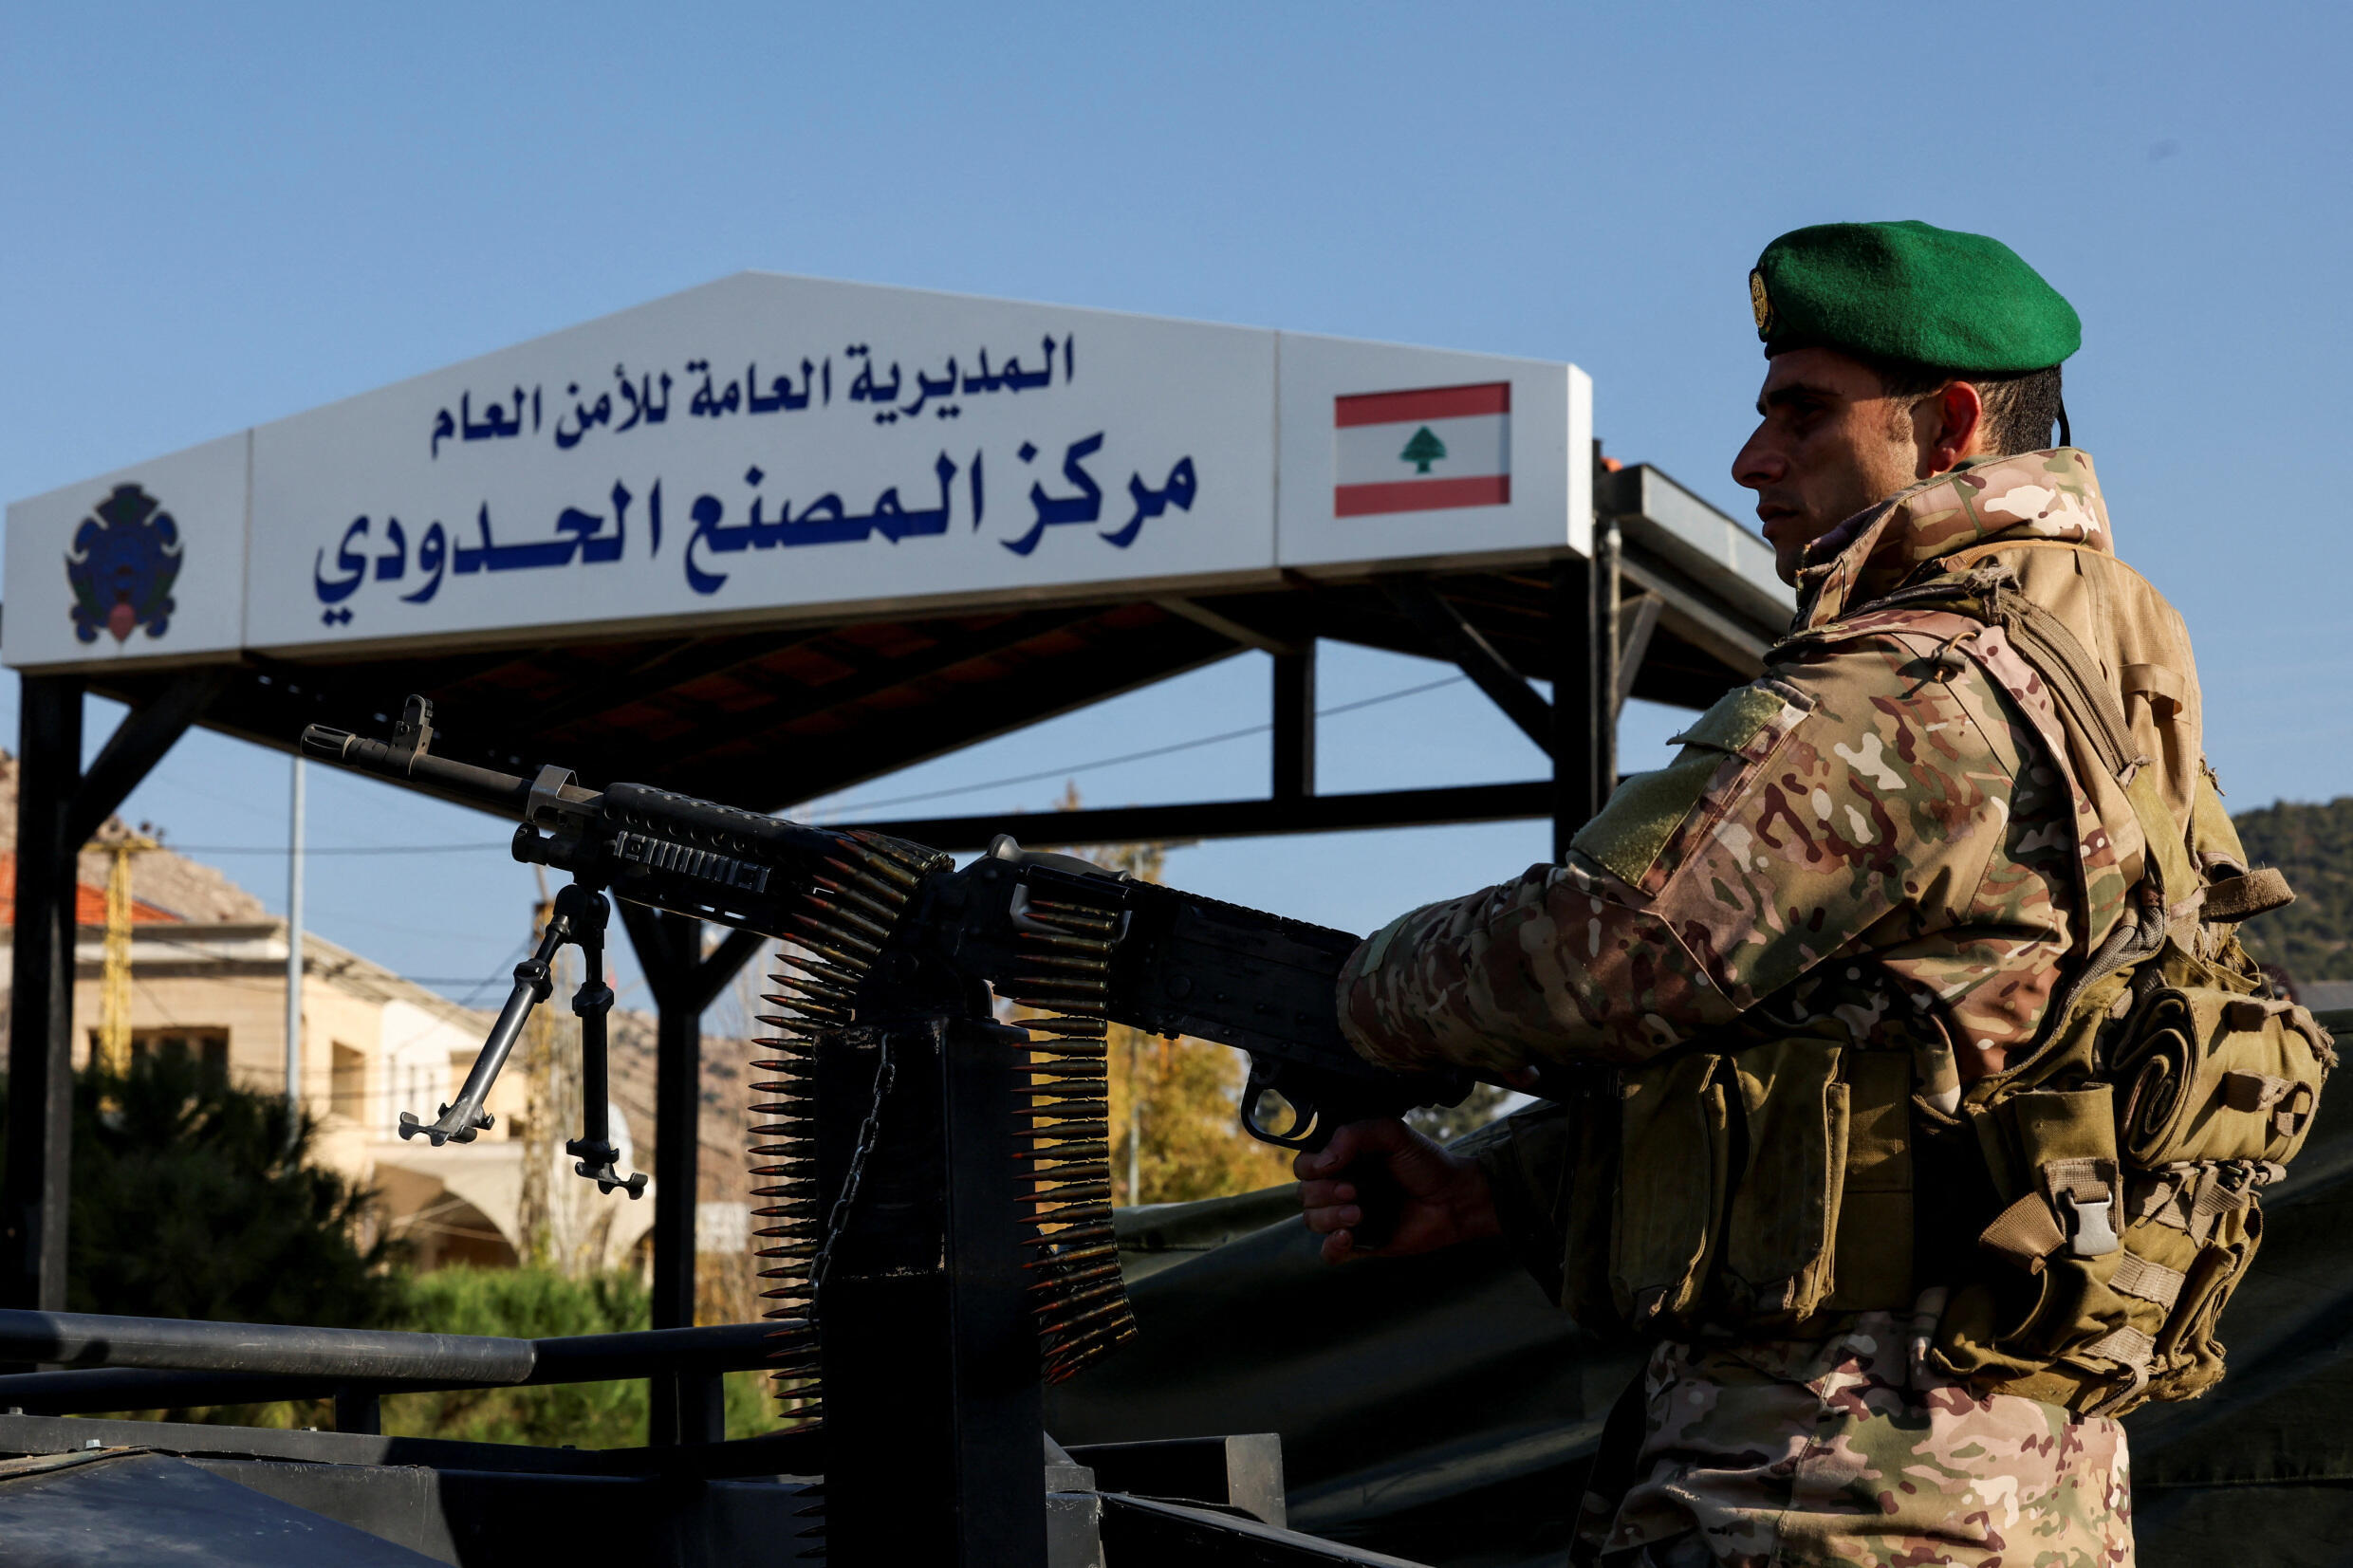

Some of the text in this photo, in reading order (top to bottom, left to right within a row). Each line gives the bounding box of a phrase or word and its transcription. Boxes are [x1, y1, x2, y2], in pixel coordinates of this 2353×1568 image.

[431, 334, 1075, 459] المديرية العامة للأمن العام
[313, 431, 1198, 628] مركز المصنع الحدودي
